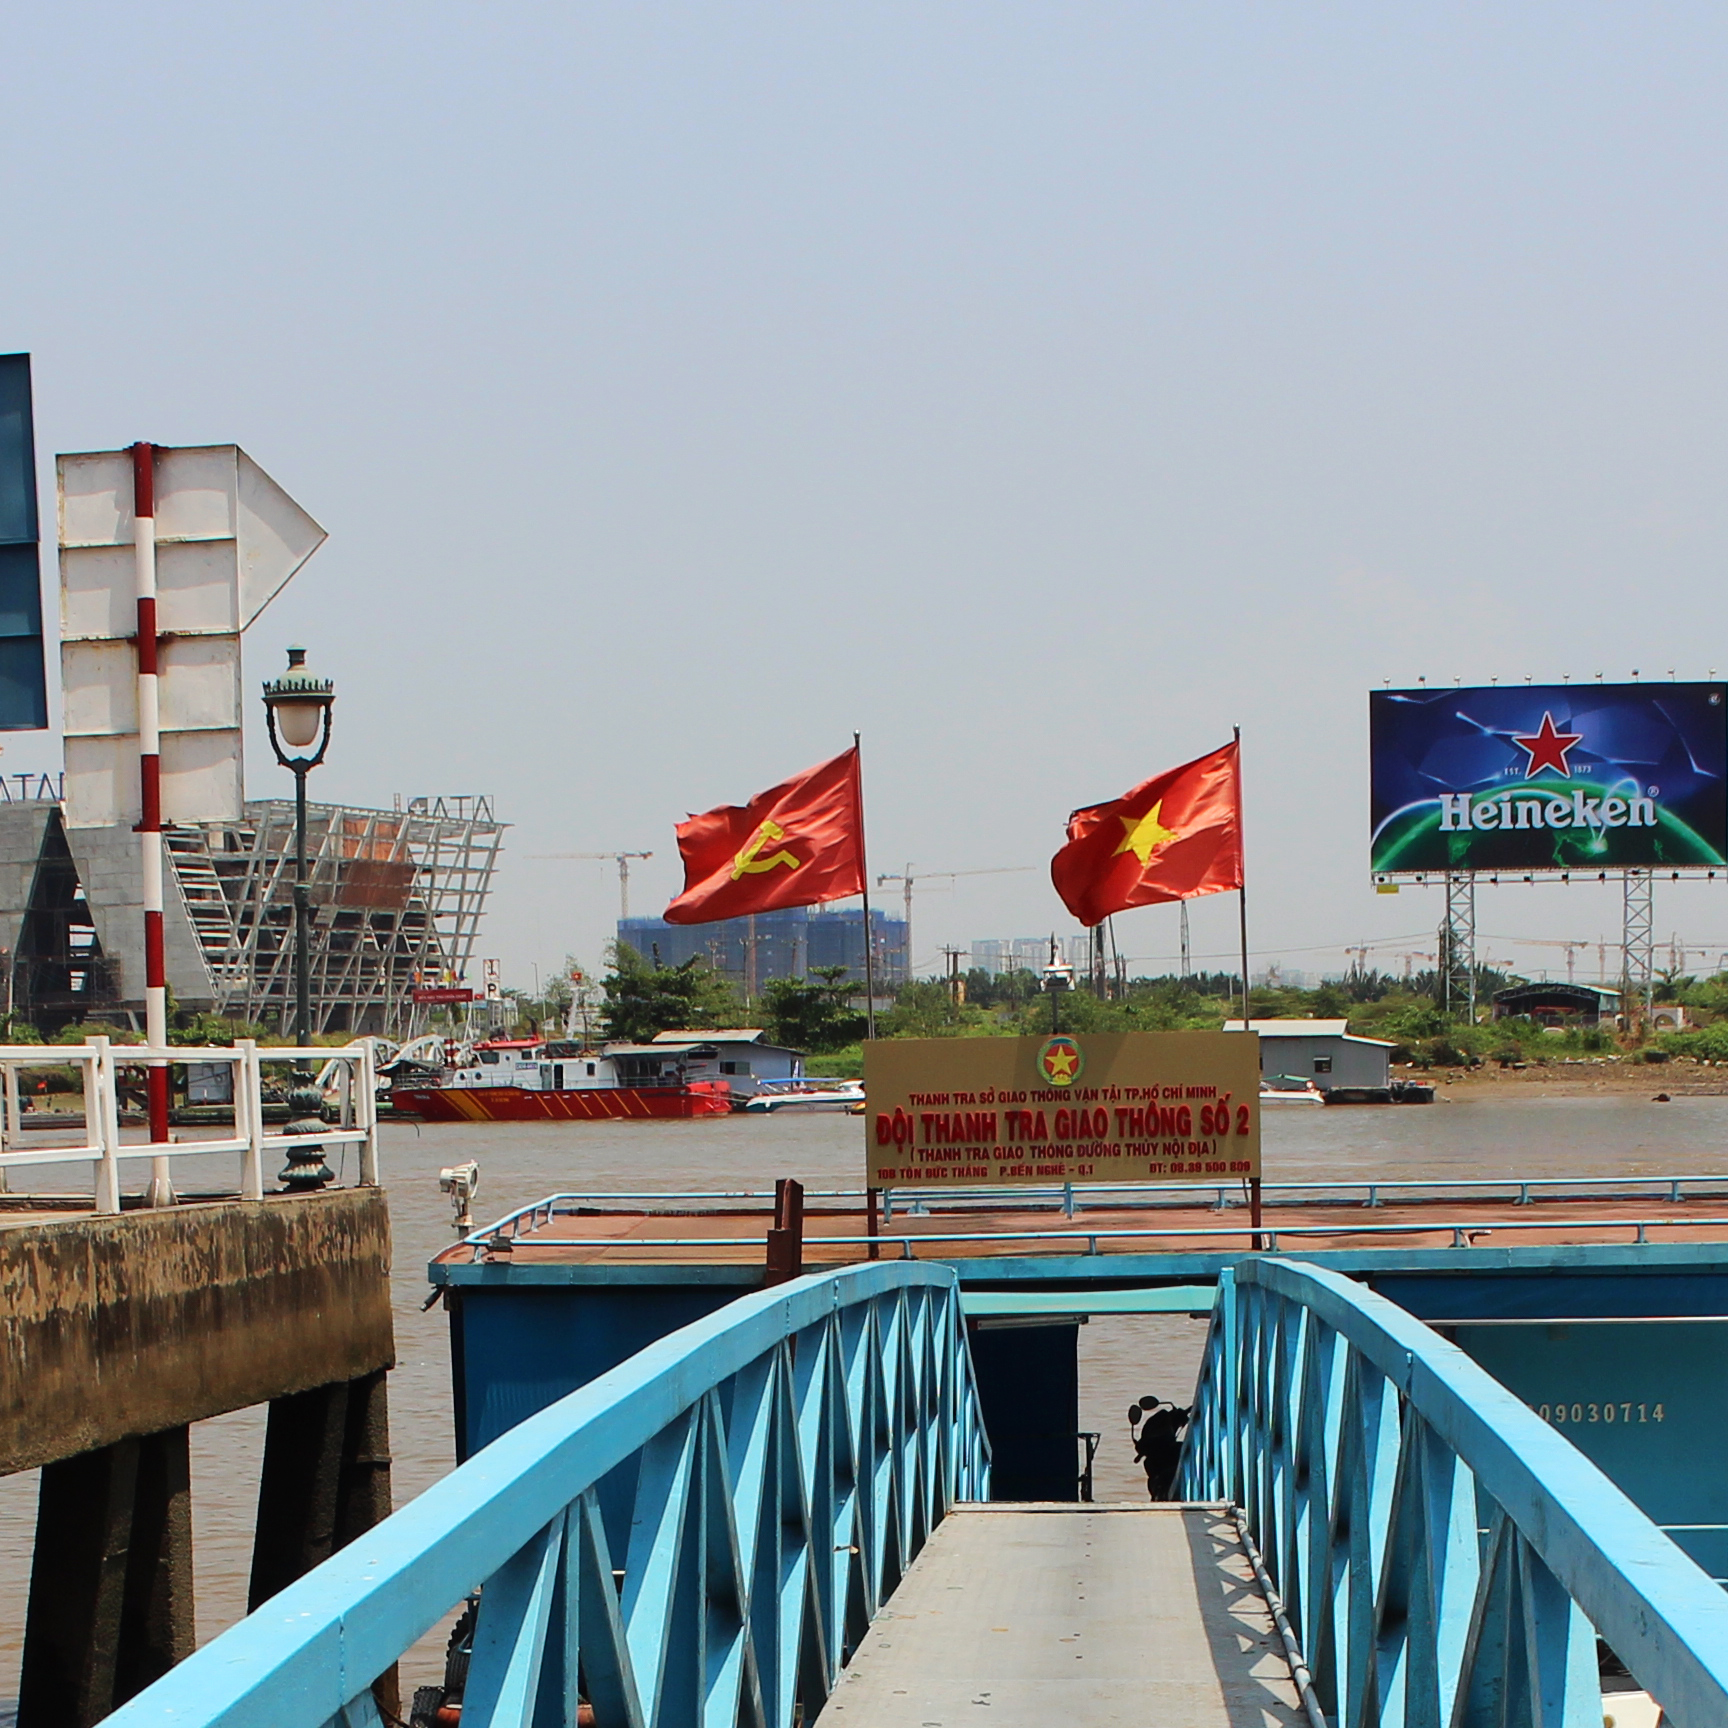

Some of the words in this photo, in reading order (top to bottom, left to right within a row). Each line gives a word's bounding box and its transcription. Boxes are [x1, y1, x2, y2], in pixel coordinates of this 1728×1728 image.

[1438, 789, 1658, 831] Heineken
[909, 1092, 950, 1107] THANH
[953, 1092, 976, 1105] TRA
[979, 1086, 996, 1104] SỞ
[998, 1091, 1027, 1103] GIAO
[1030, 1088, 1071, 1103] THÔNG
[1074, 1087, 1099, 1106] VẬN
[1162, 1083, 1183, 1099] CHÍ
[1186, 1086, 1217, 1099] MINH
[876, 1105, 915, 1153] ĐỘI
[921, 1111, 997, 1145] THANH
[1004, 1109, 1049, 1142] TRA
[1054, 1106, 1109, 1140] GIAO
[1115, 1099, 1192, 1138] THÔNG
[1200, 1091, 1231, 1136] SỐ
[1236, 1103, 1250, 1136] 2
[966, 1147, 991, 1161] TRA
[993, 1146, 1024, 1160] GIAO
[1030, 1143, 1073, 1159] THÔNG
[1077, 1140, 1121, 1158] ĐƯỜNG
[1125, 1139, 1159, 1157] THỦY
[1163, 1138, 1184, 1159] NỘI
[1528, 1402, 1665, 1424] 09030714
